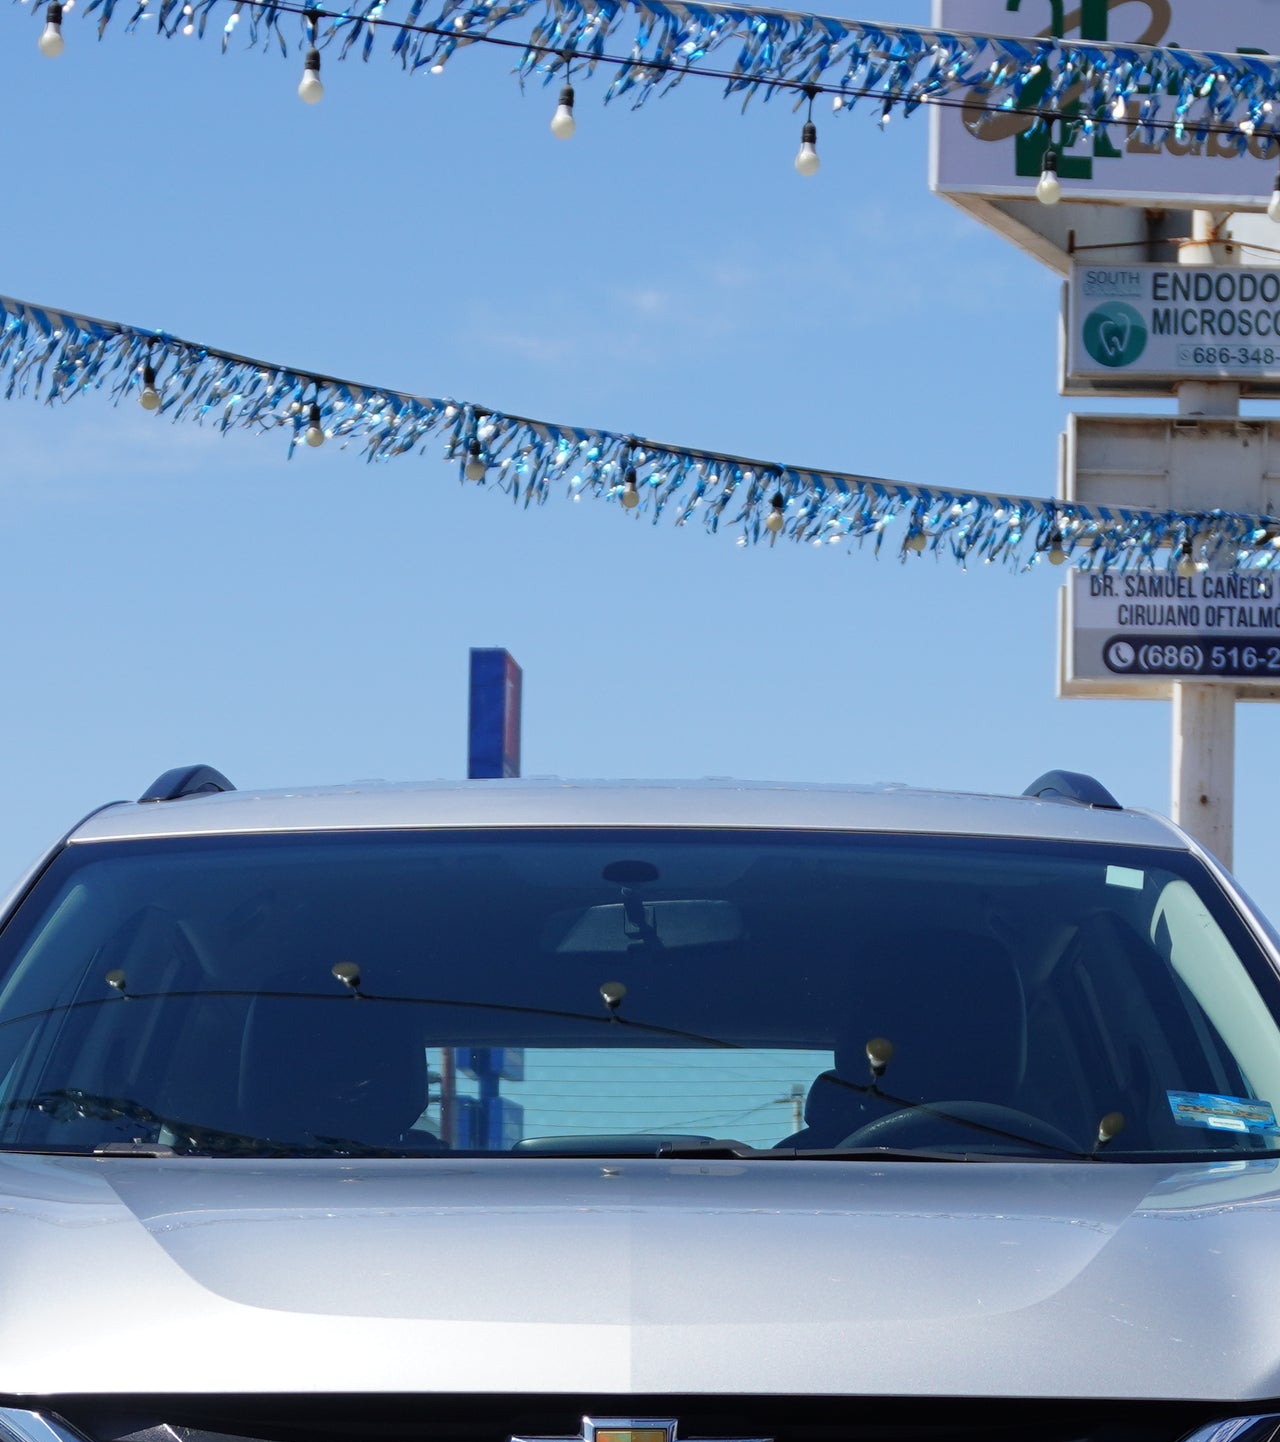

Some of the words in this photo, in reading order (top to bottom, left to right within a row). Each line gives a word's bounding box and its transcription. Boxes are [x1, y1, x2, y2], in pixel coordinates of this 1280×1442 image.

[1086, 270, 1140, 285] SOUTH
[1089, 574, 1119, 597] DR.
[1125, 575, 1197, 598] SAMUEL
[1118, 604, 1200, 627] CIRUJANO
[1138, 644, 1204, 670] (686)
